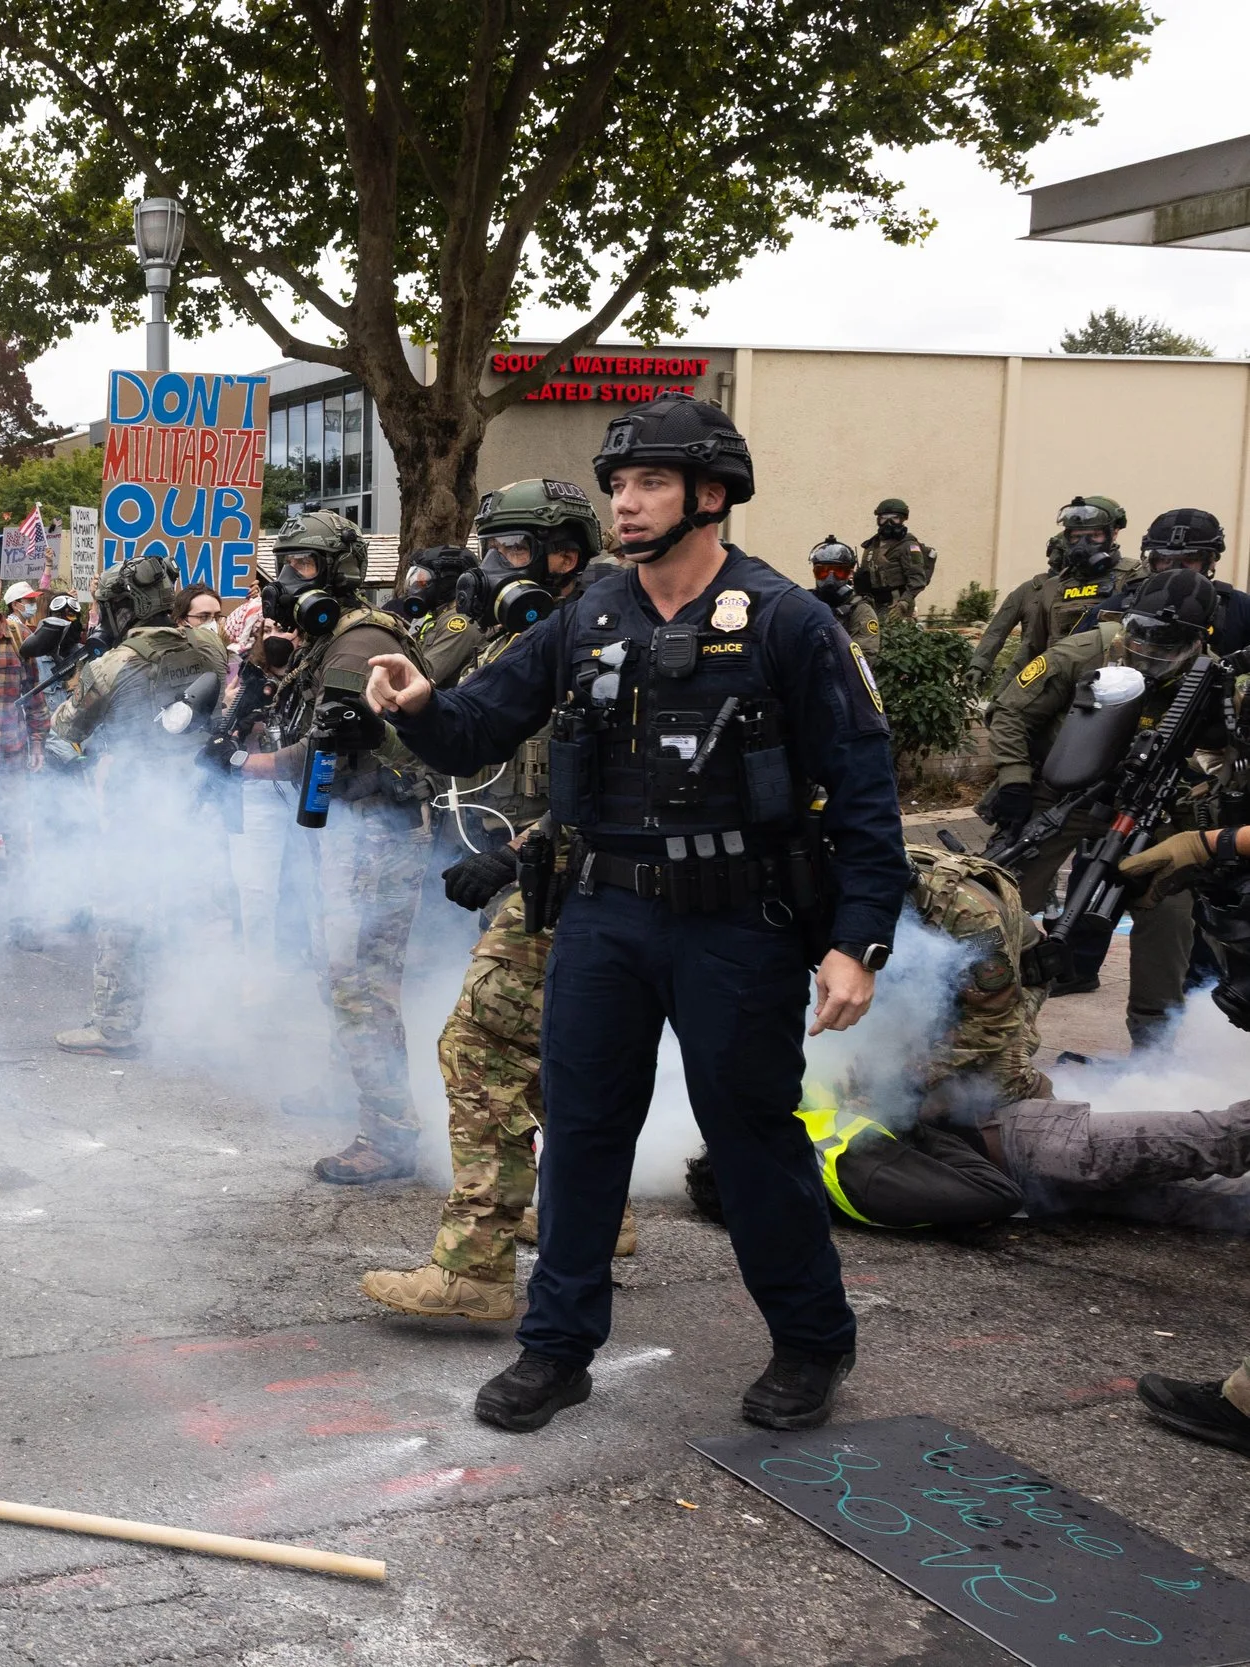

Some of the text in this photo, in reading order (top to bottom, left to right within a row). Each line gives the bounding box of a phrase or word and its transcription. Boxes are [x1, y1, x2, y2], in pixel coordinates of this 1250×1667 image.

[493, 354, 710, 376] SOU WATERFRONT
[110, 370, 267, 429] DON'T
[523, 383, 592, 400] ATED
[102, 424, 266, 488] MILITARIZE
[76, 510, 90, 520] YOUR
[103, 482, 252, 540] OUR
[73, 522, 96, 536] HUMANITY
[103, 538, 255, 599] HME
[1064, 585, 1099, 599] POLICE
[702, 643, 742, 654] POLICE
[169, 664, 200, 680] POLICE
